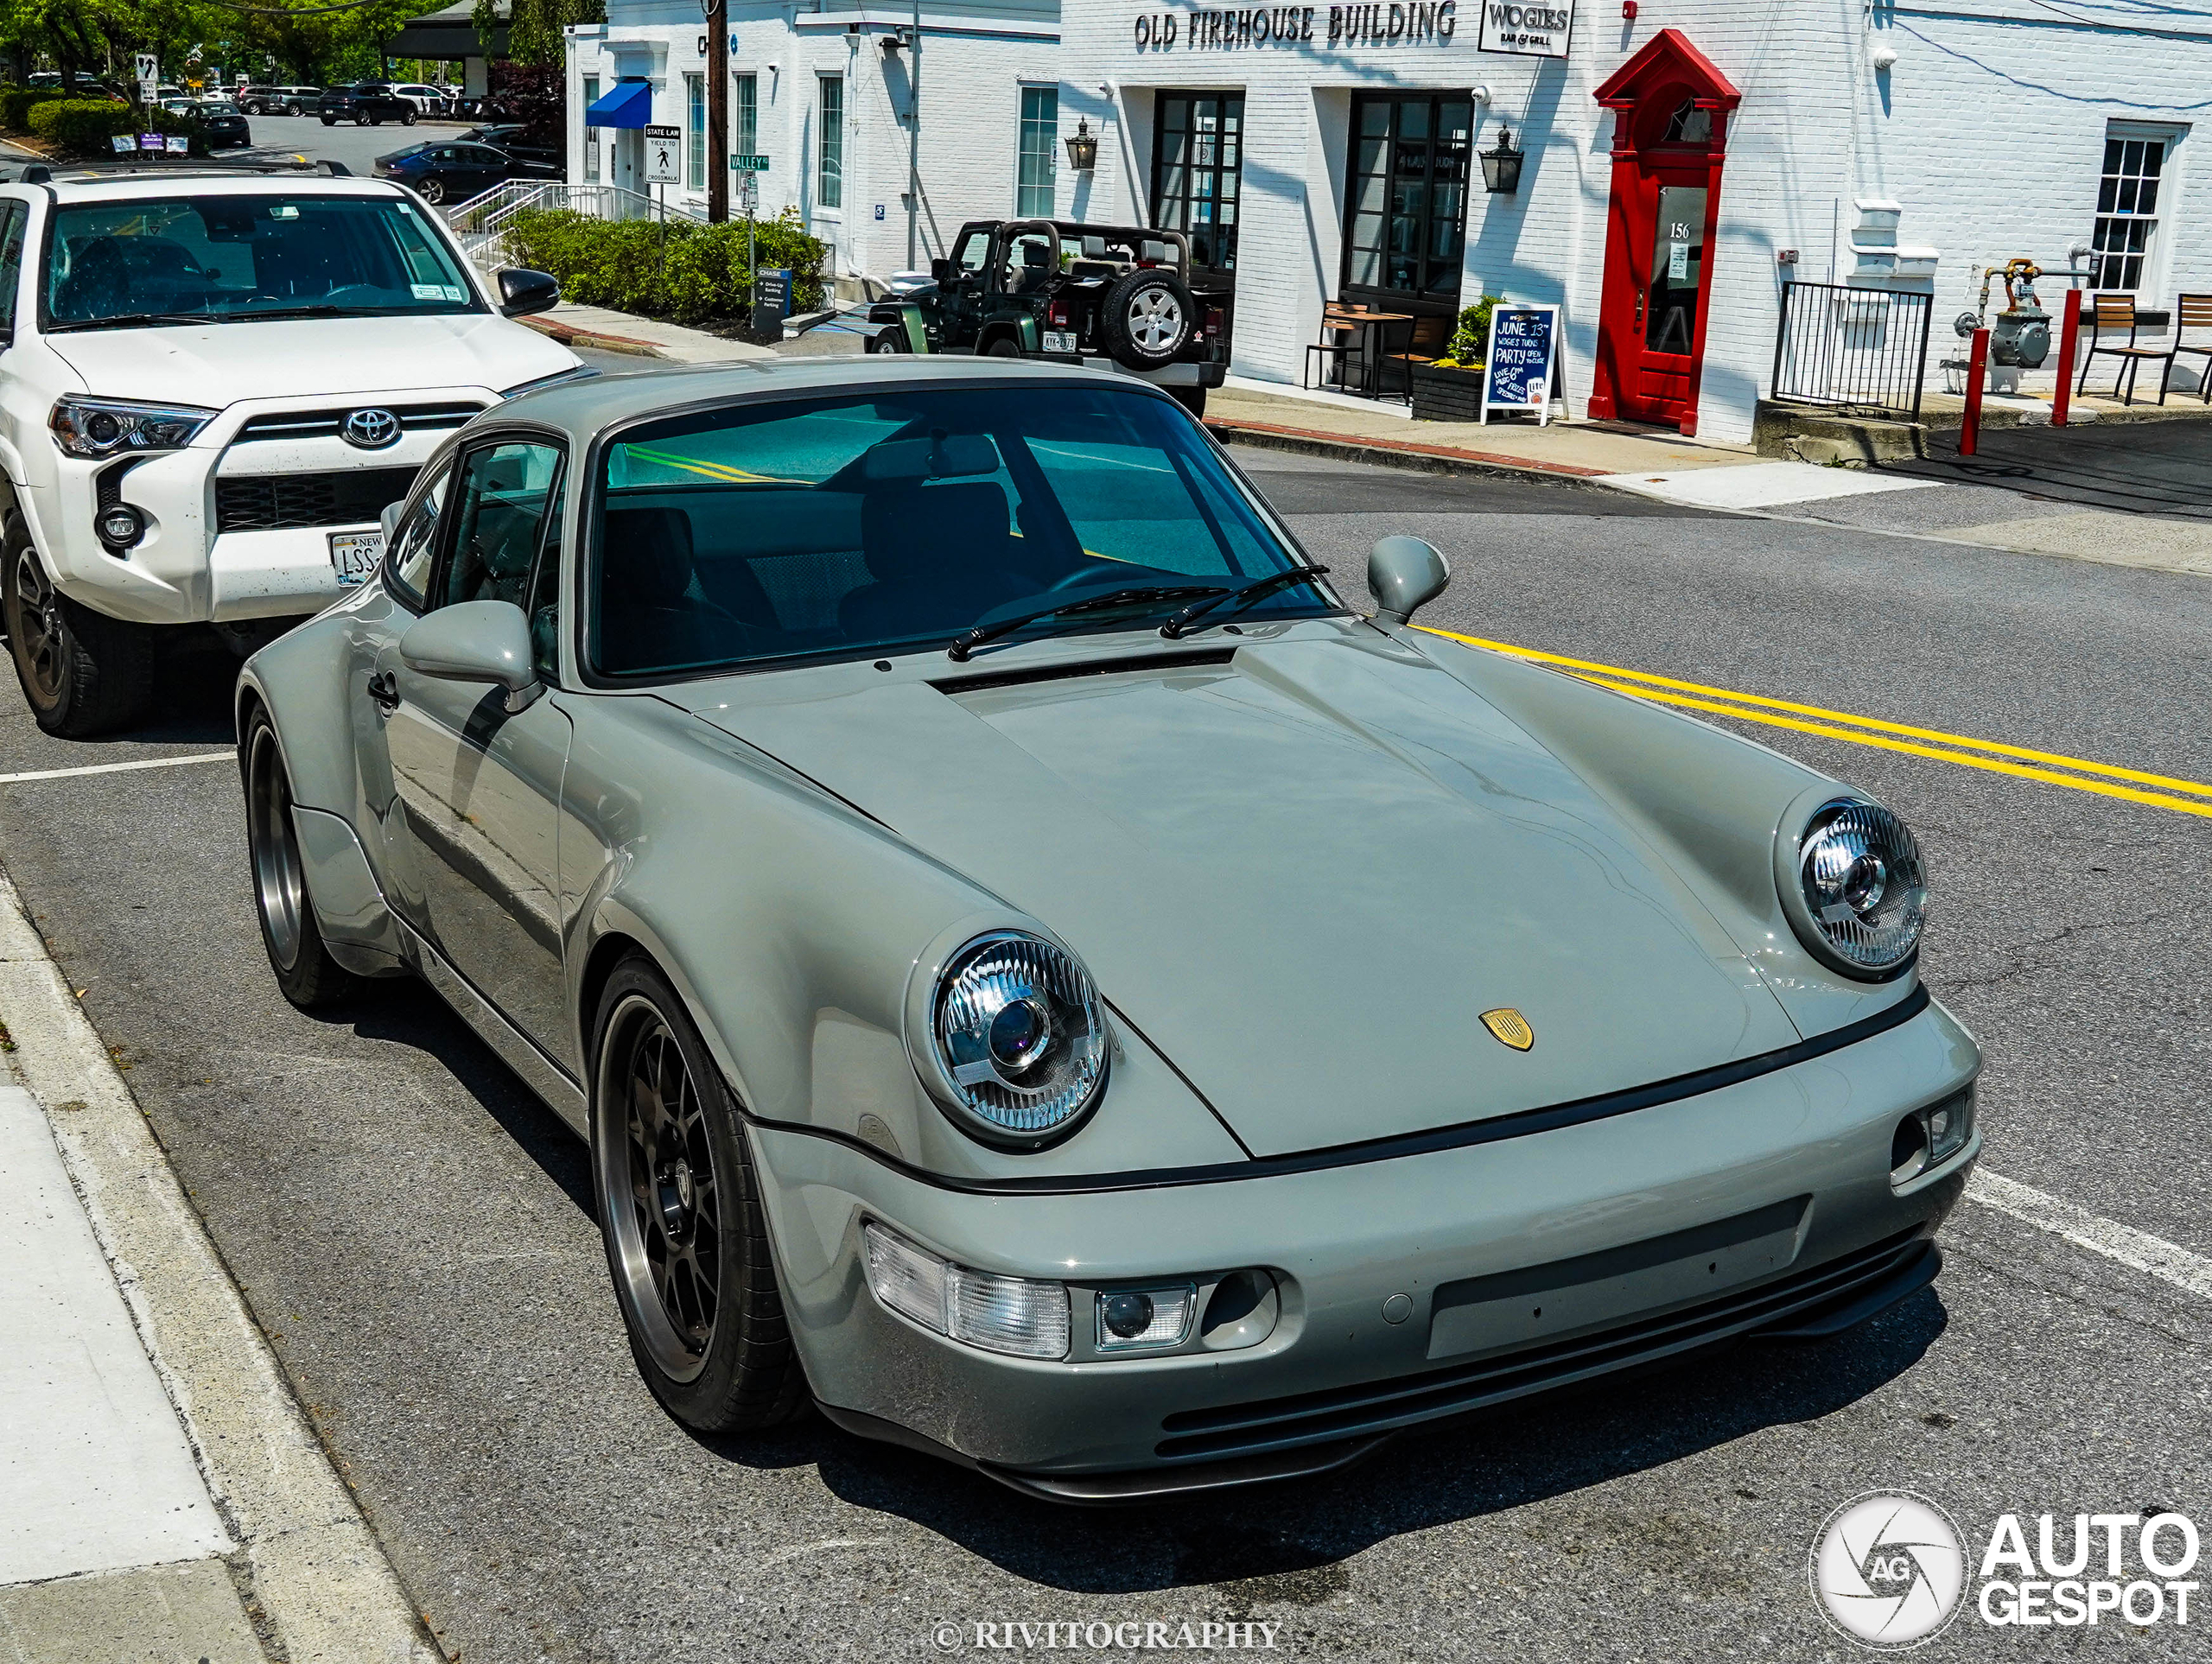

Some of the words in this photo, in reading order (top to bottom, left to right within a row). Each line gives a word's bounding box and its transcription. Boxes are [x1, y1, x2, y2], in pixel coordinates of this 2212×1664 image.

[1135, 14, 1177, 45] OLD
[1189, 8, 1314, 44] FIREHOUSE
[1328, 1, 1456, 41] BUILDING
[1490, 4, 1568, 30] WOGIES
[1501, 34, 1516, 42] BAR
[1518, 35, 1529, 44] &
[1529, 35, 1551, 45] GRILL
[731, 156, 762, 169] VALLEY
[1670, 223, 1690, 238] 156
[1497, 322, 1527, 336] JUNE
[1497, 338, 1520, 346] WOGIES
[1522, 339, 1538, 347] TURNS
[1496, 347, 1526, 365] PARTY
[1494, 367, 1510, 378] LIVE
[1496, 377, 1510, 386] MUSIC
[1529, 383, 1543, 392] Lite
[1507, 383, 1525, 395] PRIZES
[359, 537, 381, 546] NEW
